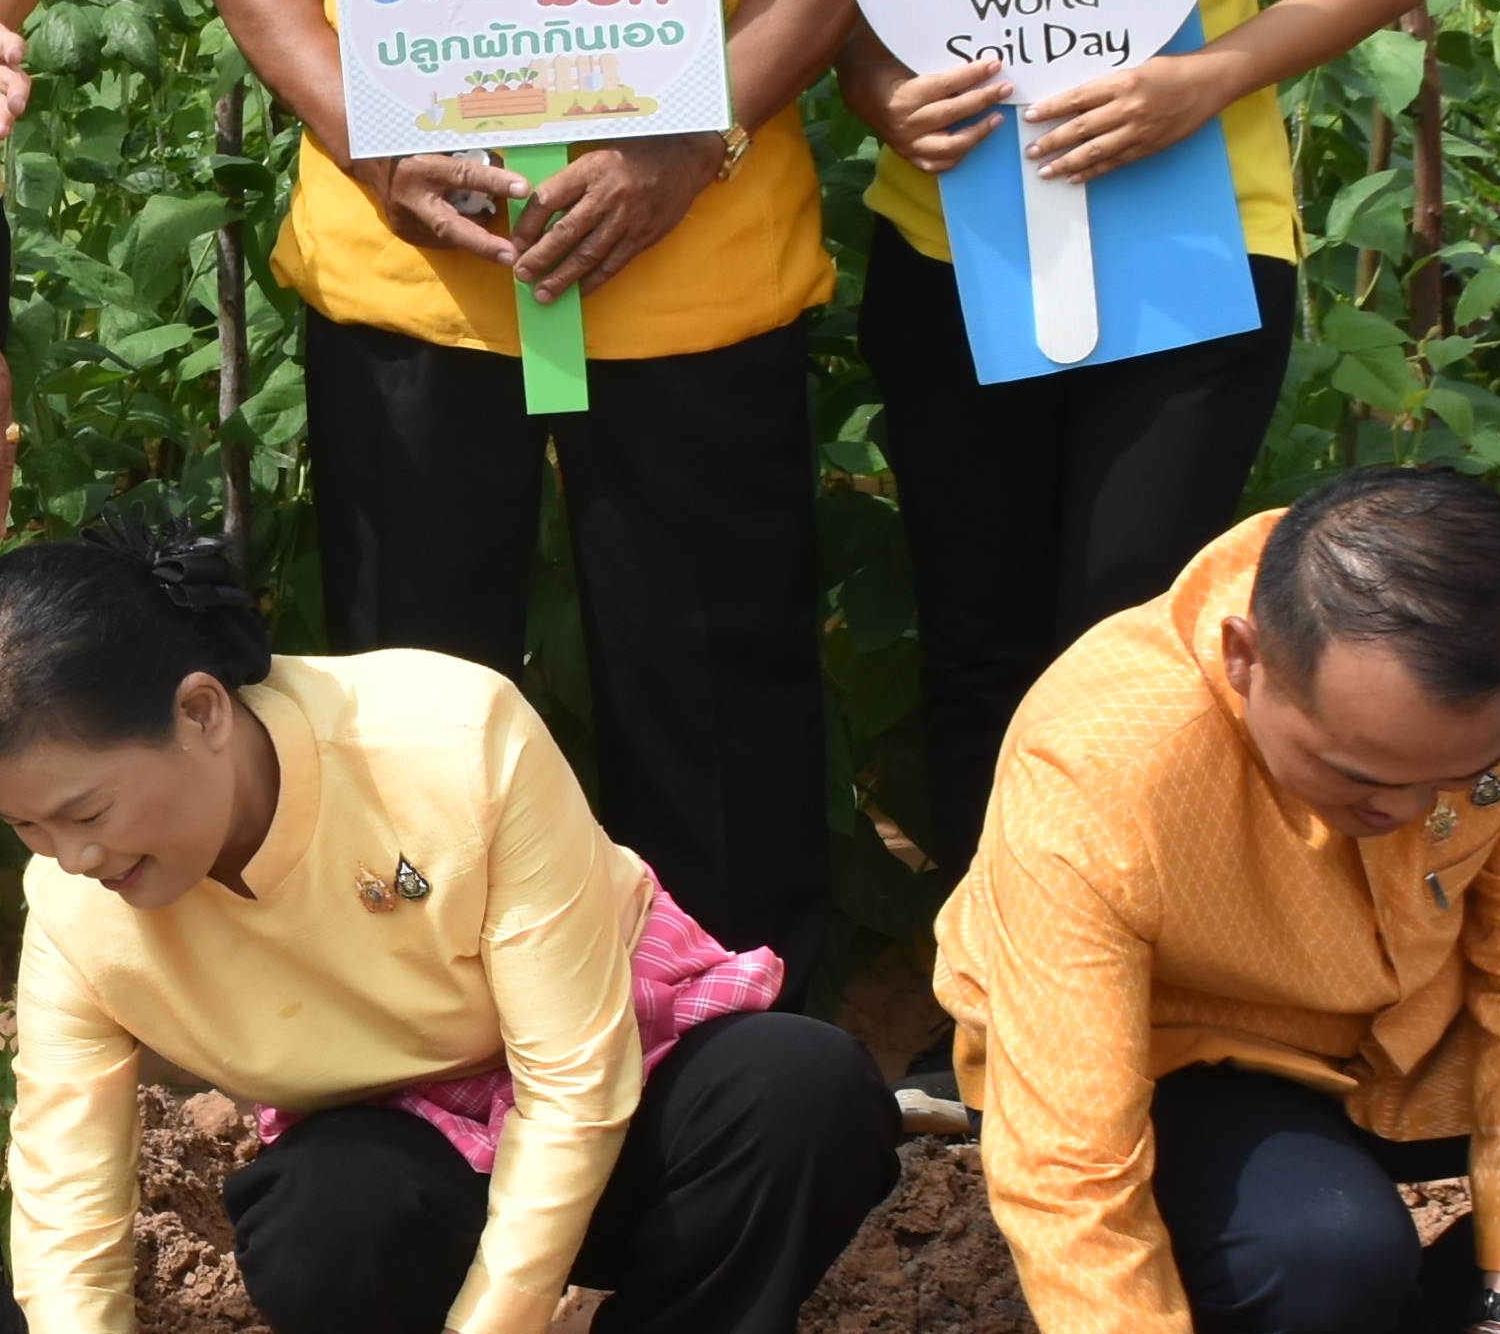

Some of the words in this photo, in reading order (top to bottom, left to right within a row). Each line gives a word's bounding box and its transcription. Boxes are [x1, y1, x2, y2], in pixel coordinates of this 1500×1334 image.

[377, 20, 685, 73] ปลูกผักกินเอง
[946, 26, 1032, 66] Soil
[1044, 22, 1131, 68] Day
